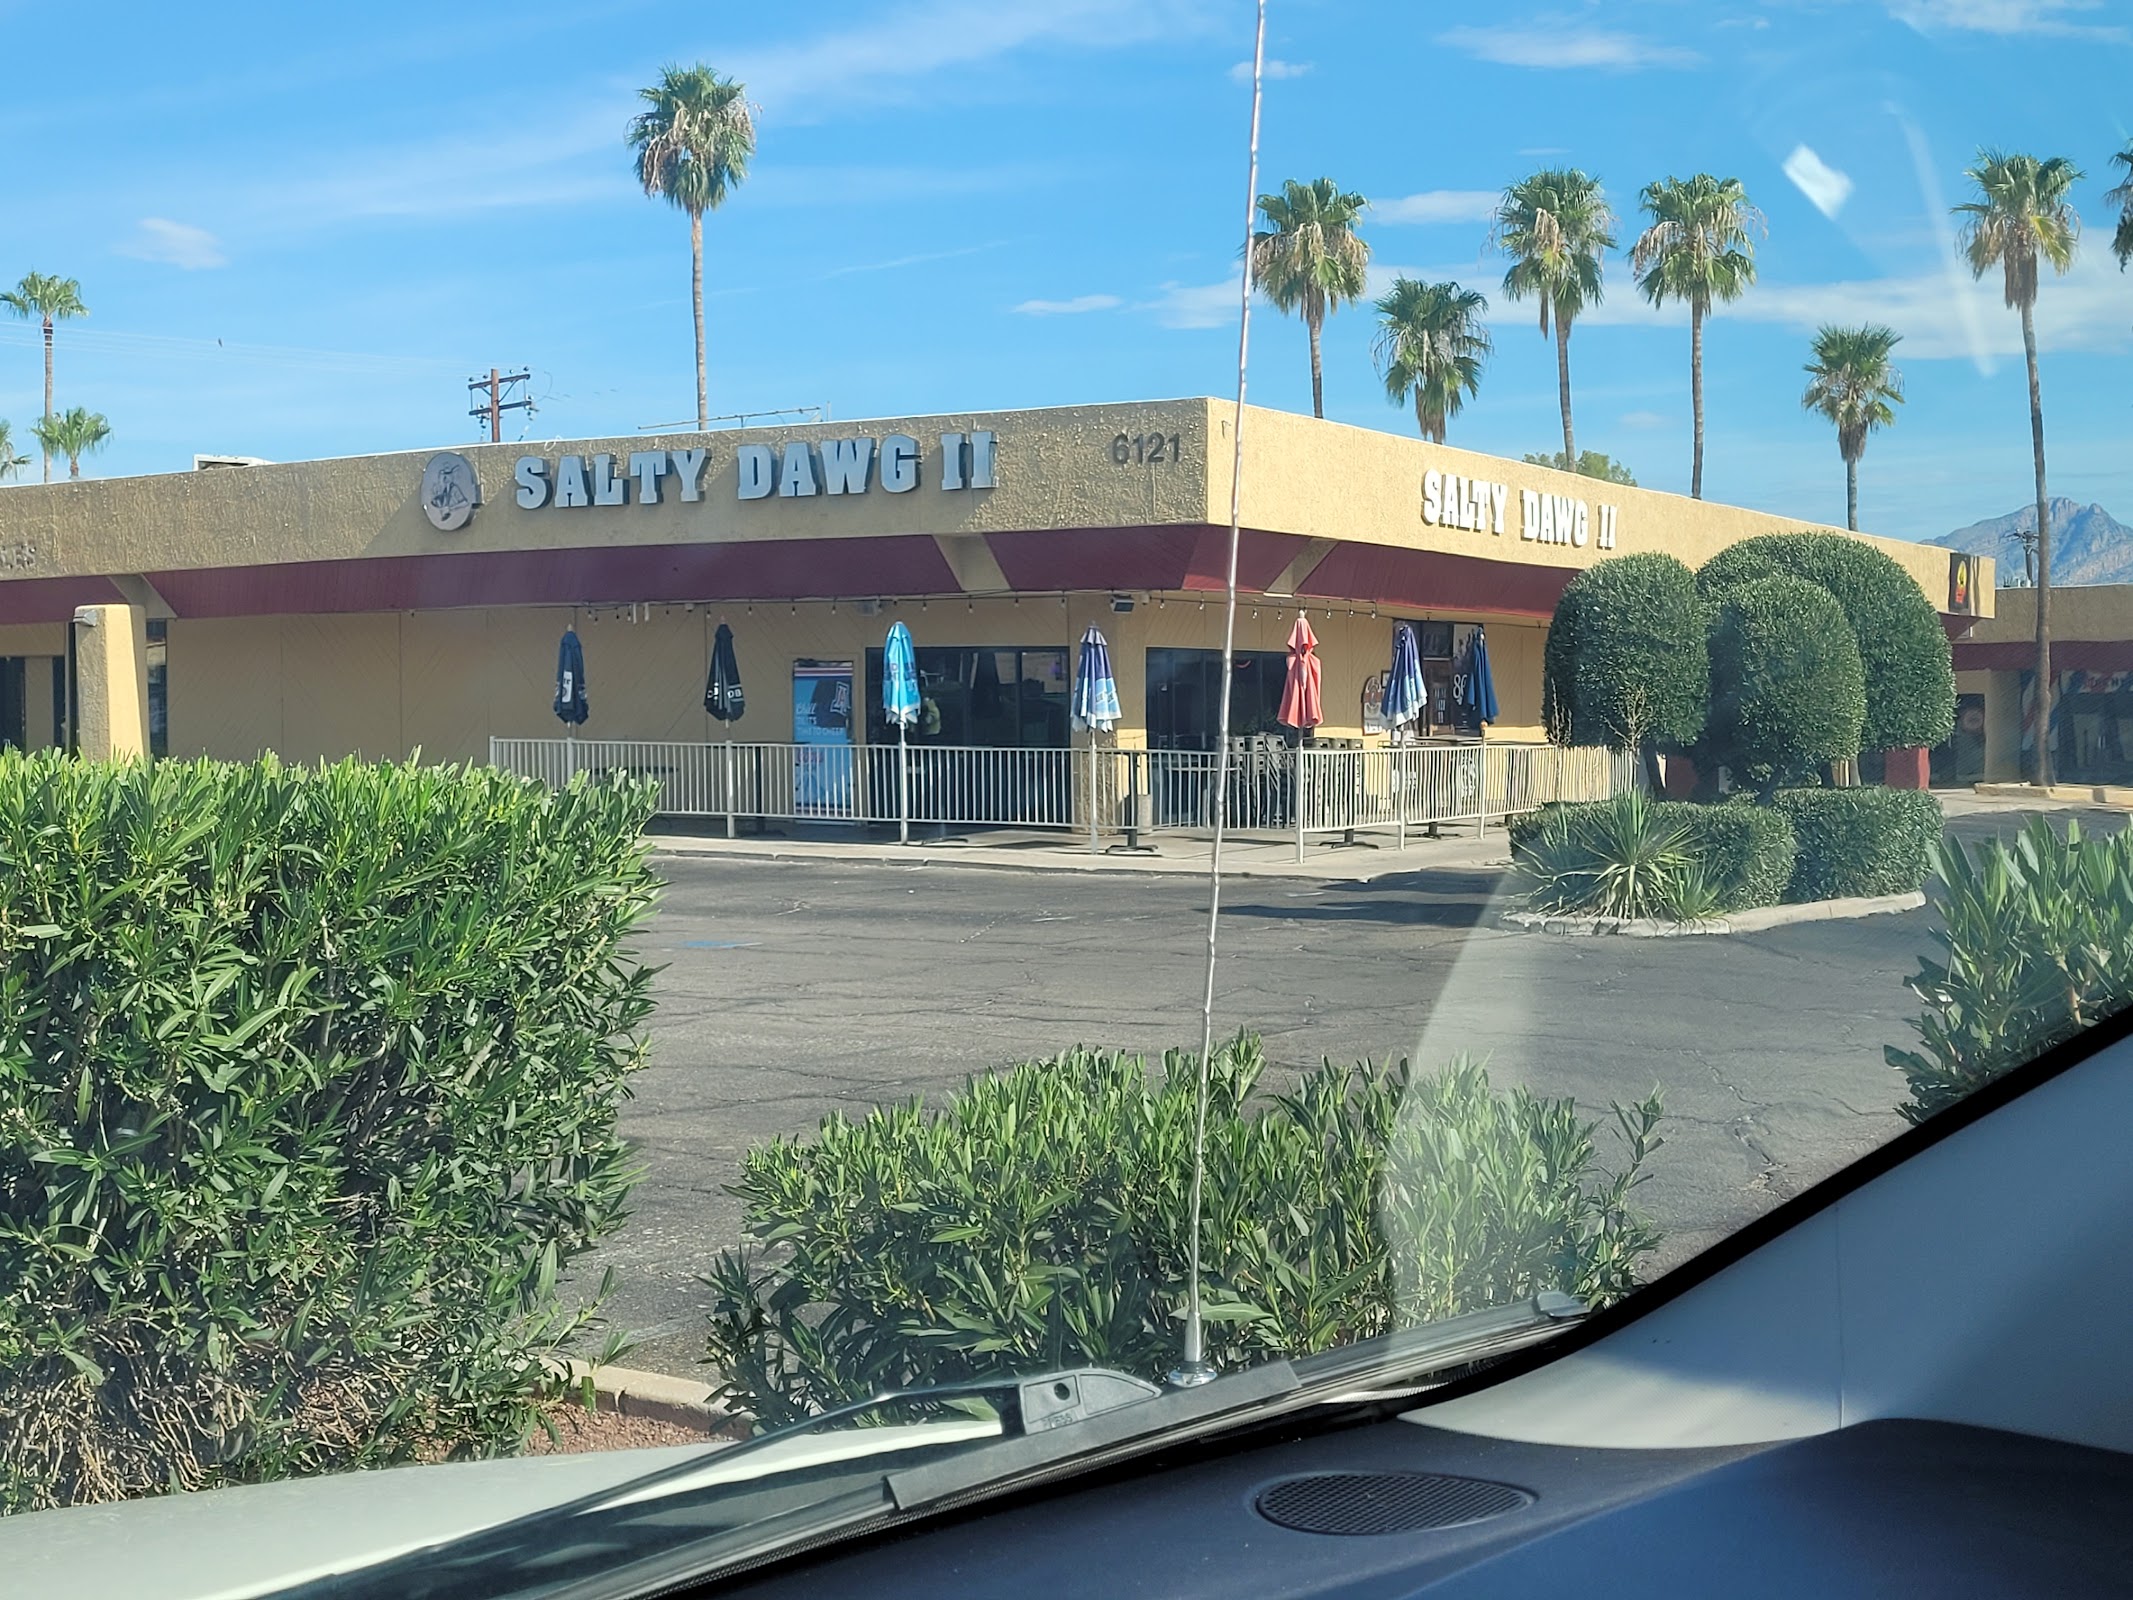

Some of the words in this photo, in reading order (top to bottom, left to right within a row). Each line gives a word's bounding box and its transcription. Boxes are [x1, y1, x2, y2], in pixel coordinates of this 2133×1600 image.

[515, 447, 709, 510] SALTY
[737, 434, 920, 500] DAWG
[941, 431, 997, 491] II
[1111, 432, 1180, 464] 6121
[1421, 468, 1508, 537] SALTY
[1519, 489, 1588, 548] DAWG
[1597, 504, 1618, 550] II
